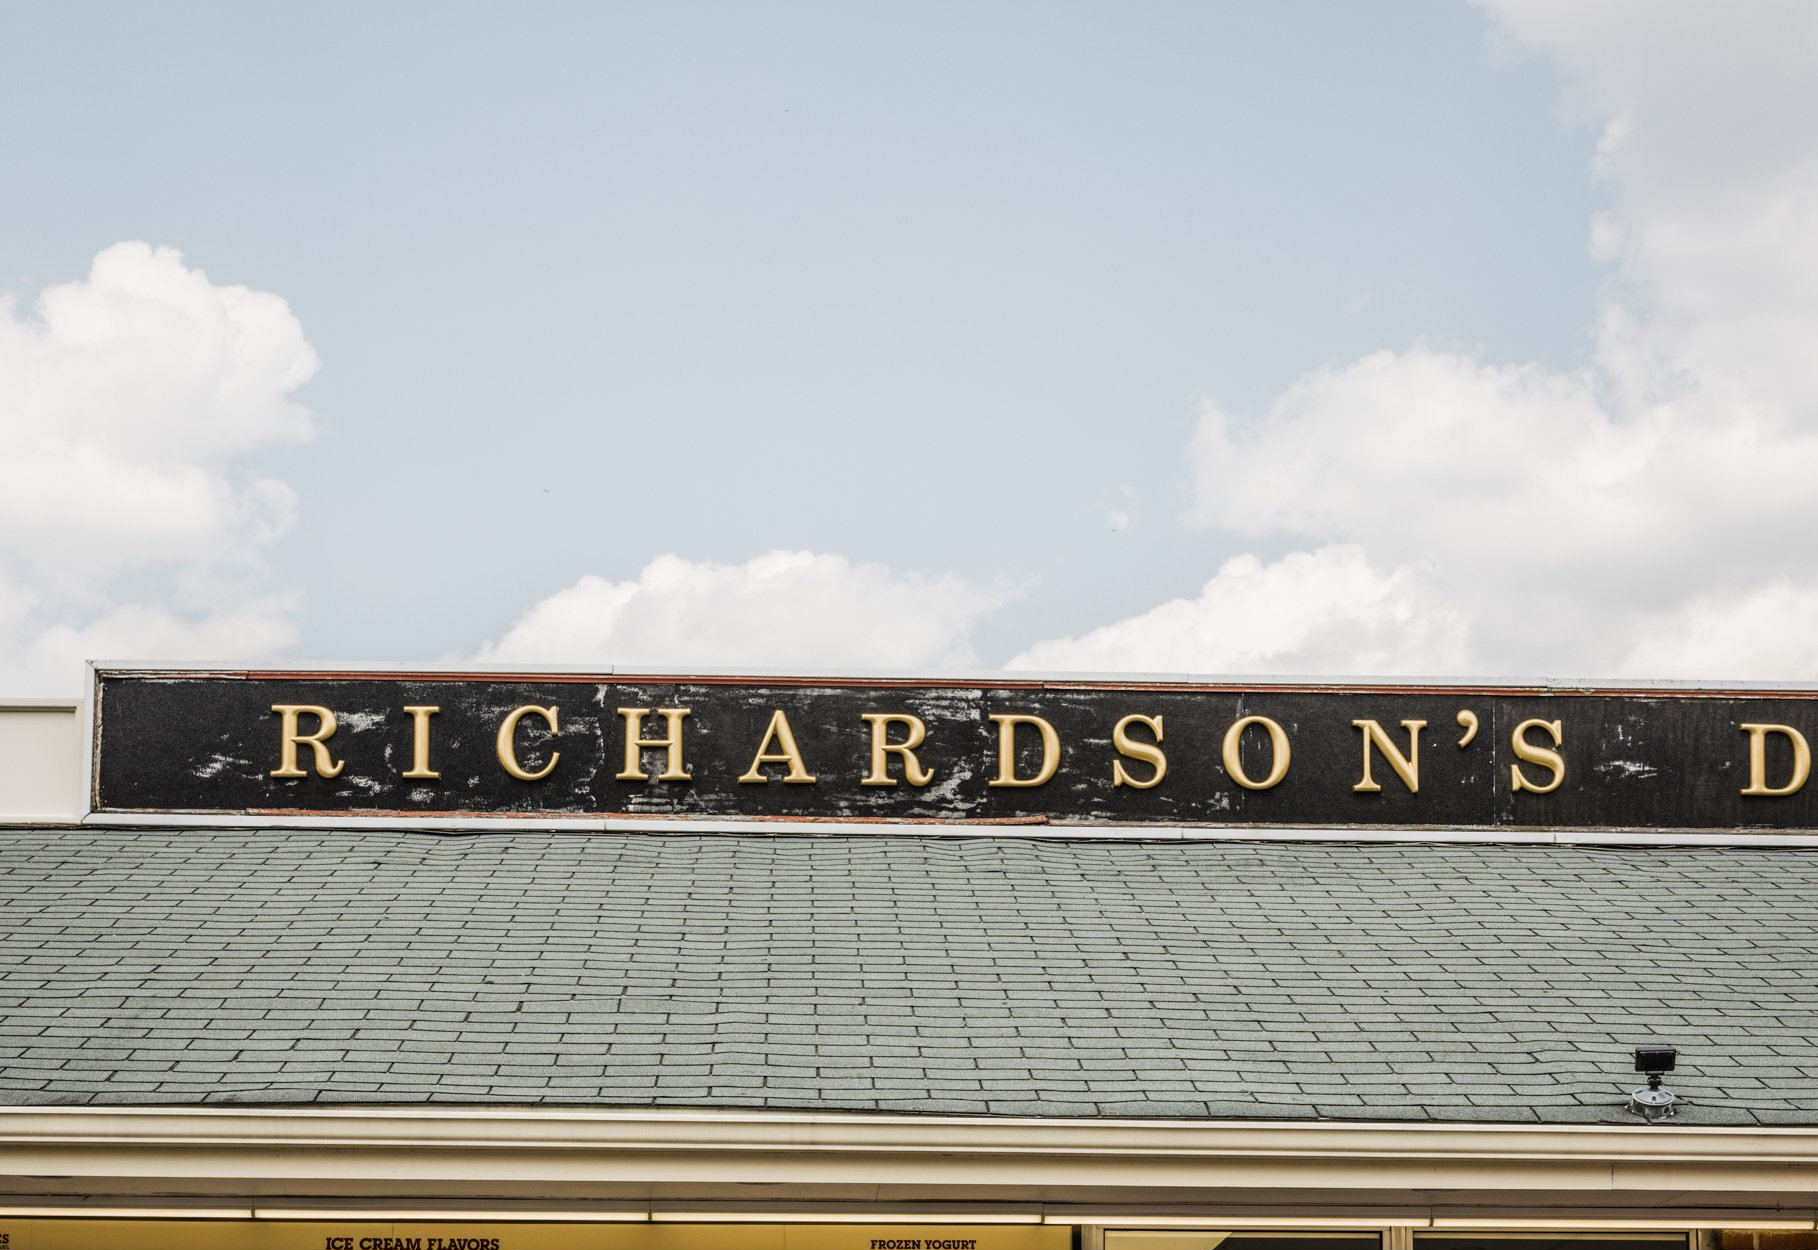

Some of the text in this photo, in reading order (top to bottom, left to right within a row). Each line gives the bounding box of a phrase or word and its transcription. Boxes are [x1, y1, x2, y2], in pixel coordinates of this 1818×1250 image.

[269, 703, 1568, 795] RICHARDSON'S
[326, 1238, 499, 1250] ICE CREAM FLAVORS
[871, 1240, 976, 1249] FROZEN YOGURT
